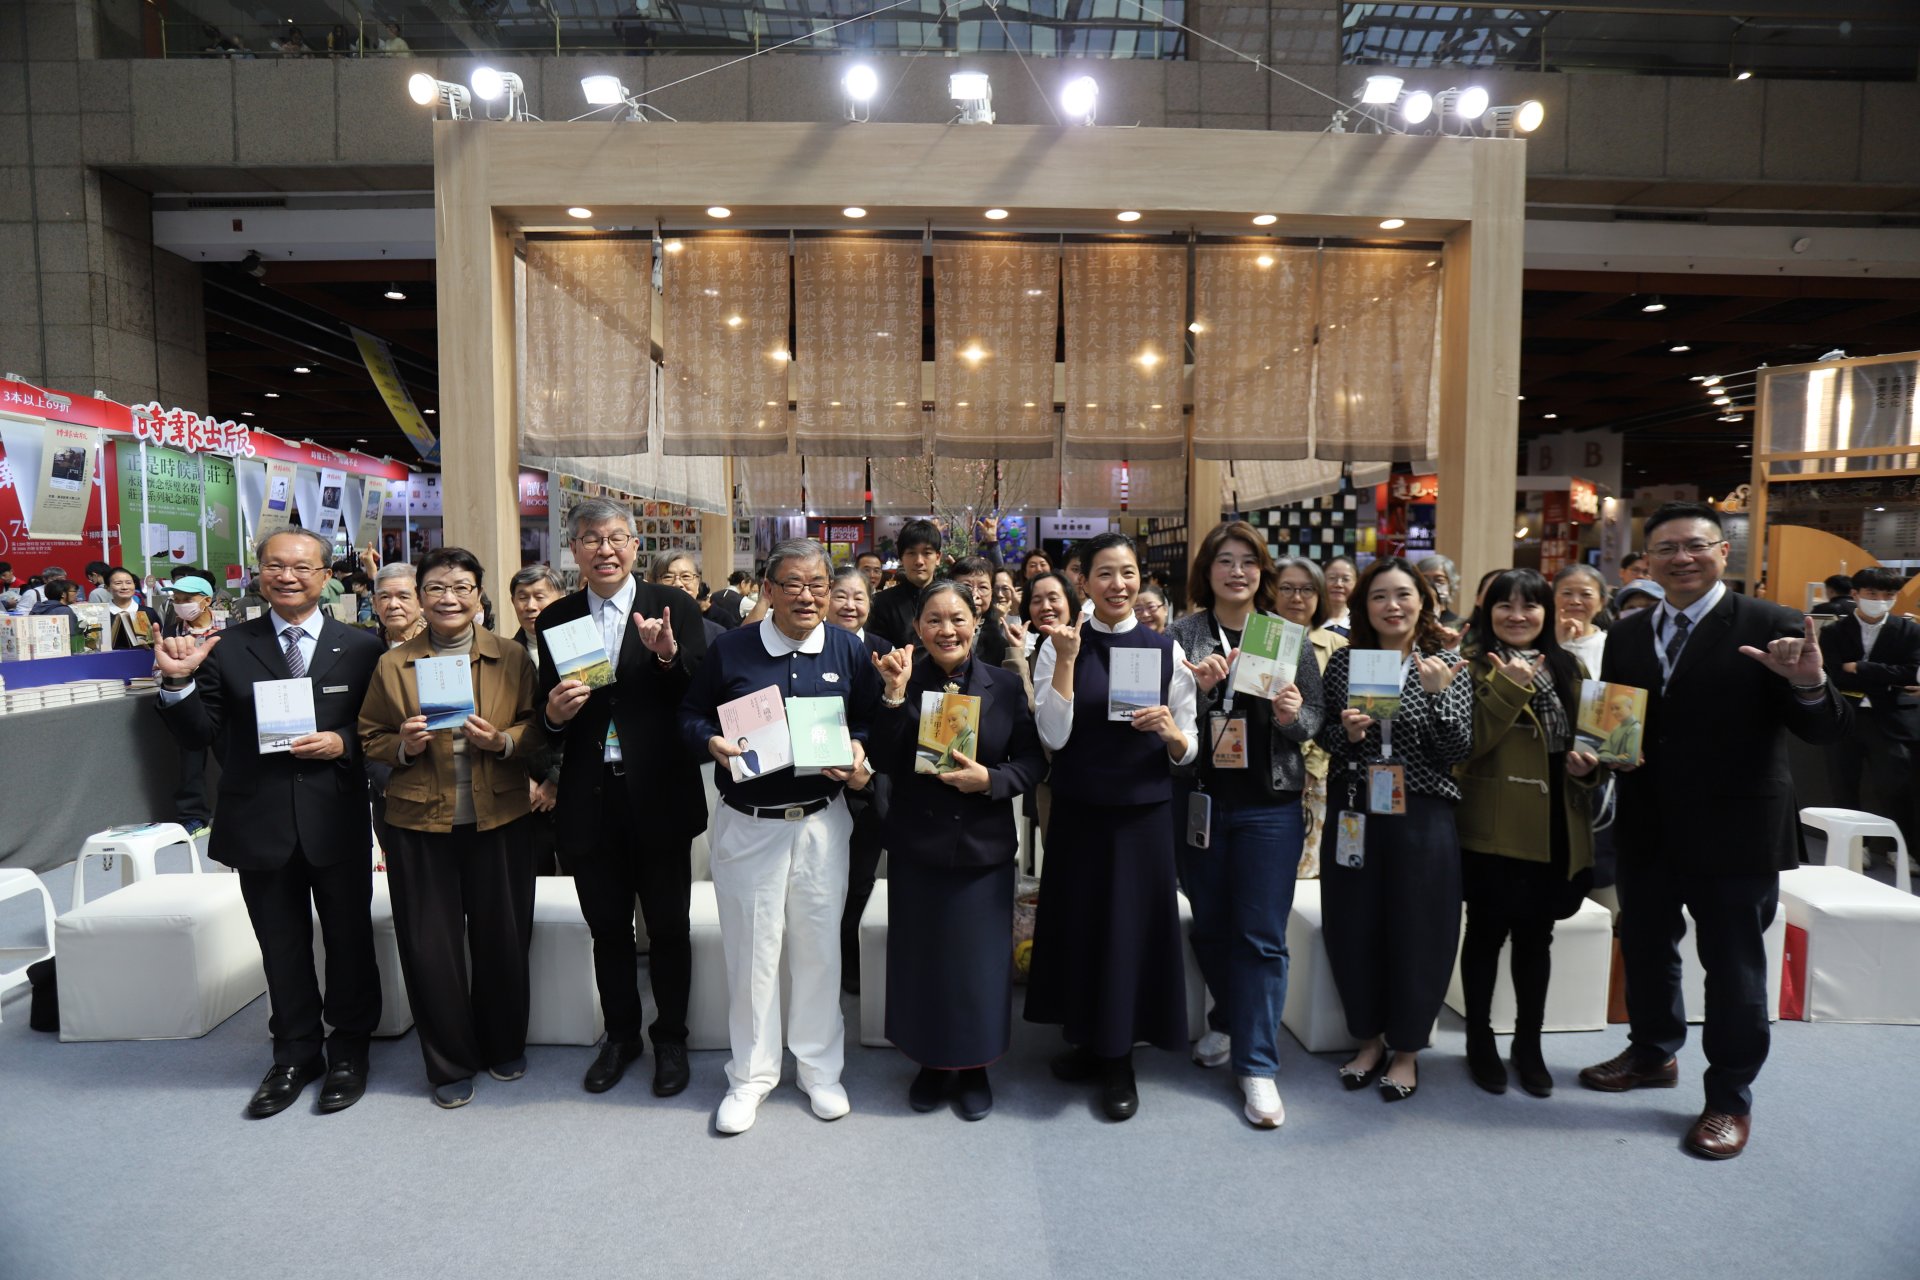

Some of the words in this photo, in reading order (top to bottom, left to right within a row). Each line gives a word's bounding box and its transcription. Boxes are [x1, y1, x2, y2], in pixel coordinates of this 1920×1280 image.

[728, 250, 747, 426] 賜或與田聚落城邑或與
[138, 404, 254, 457] 時報出版
[1585, 442, 1602, 468] B
